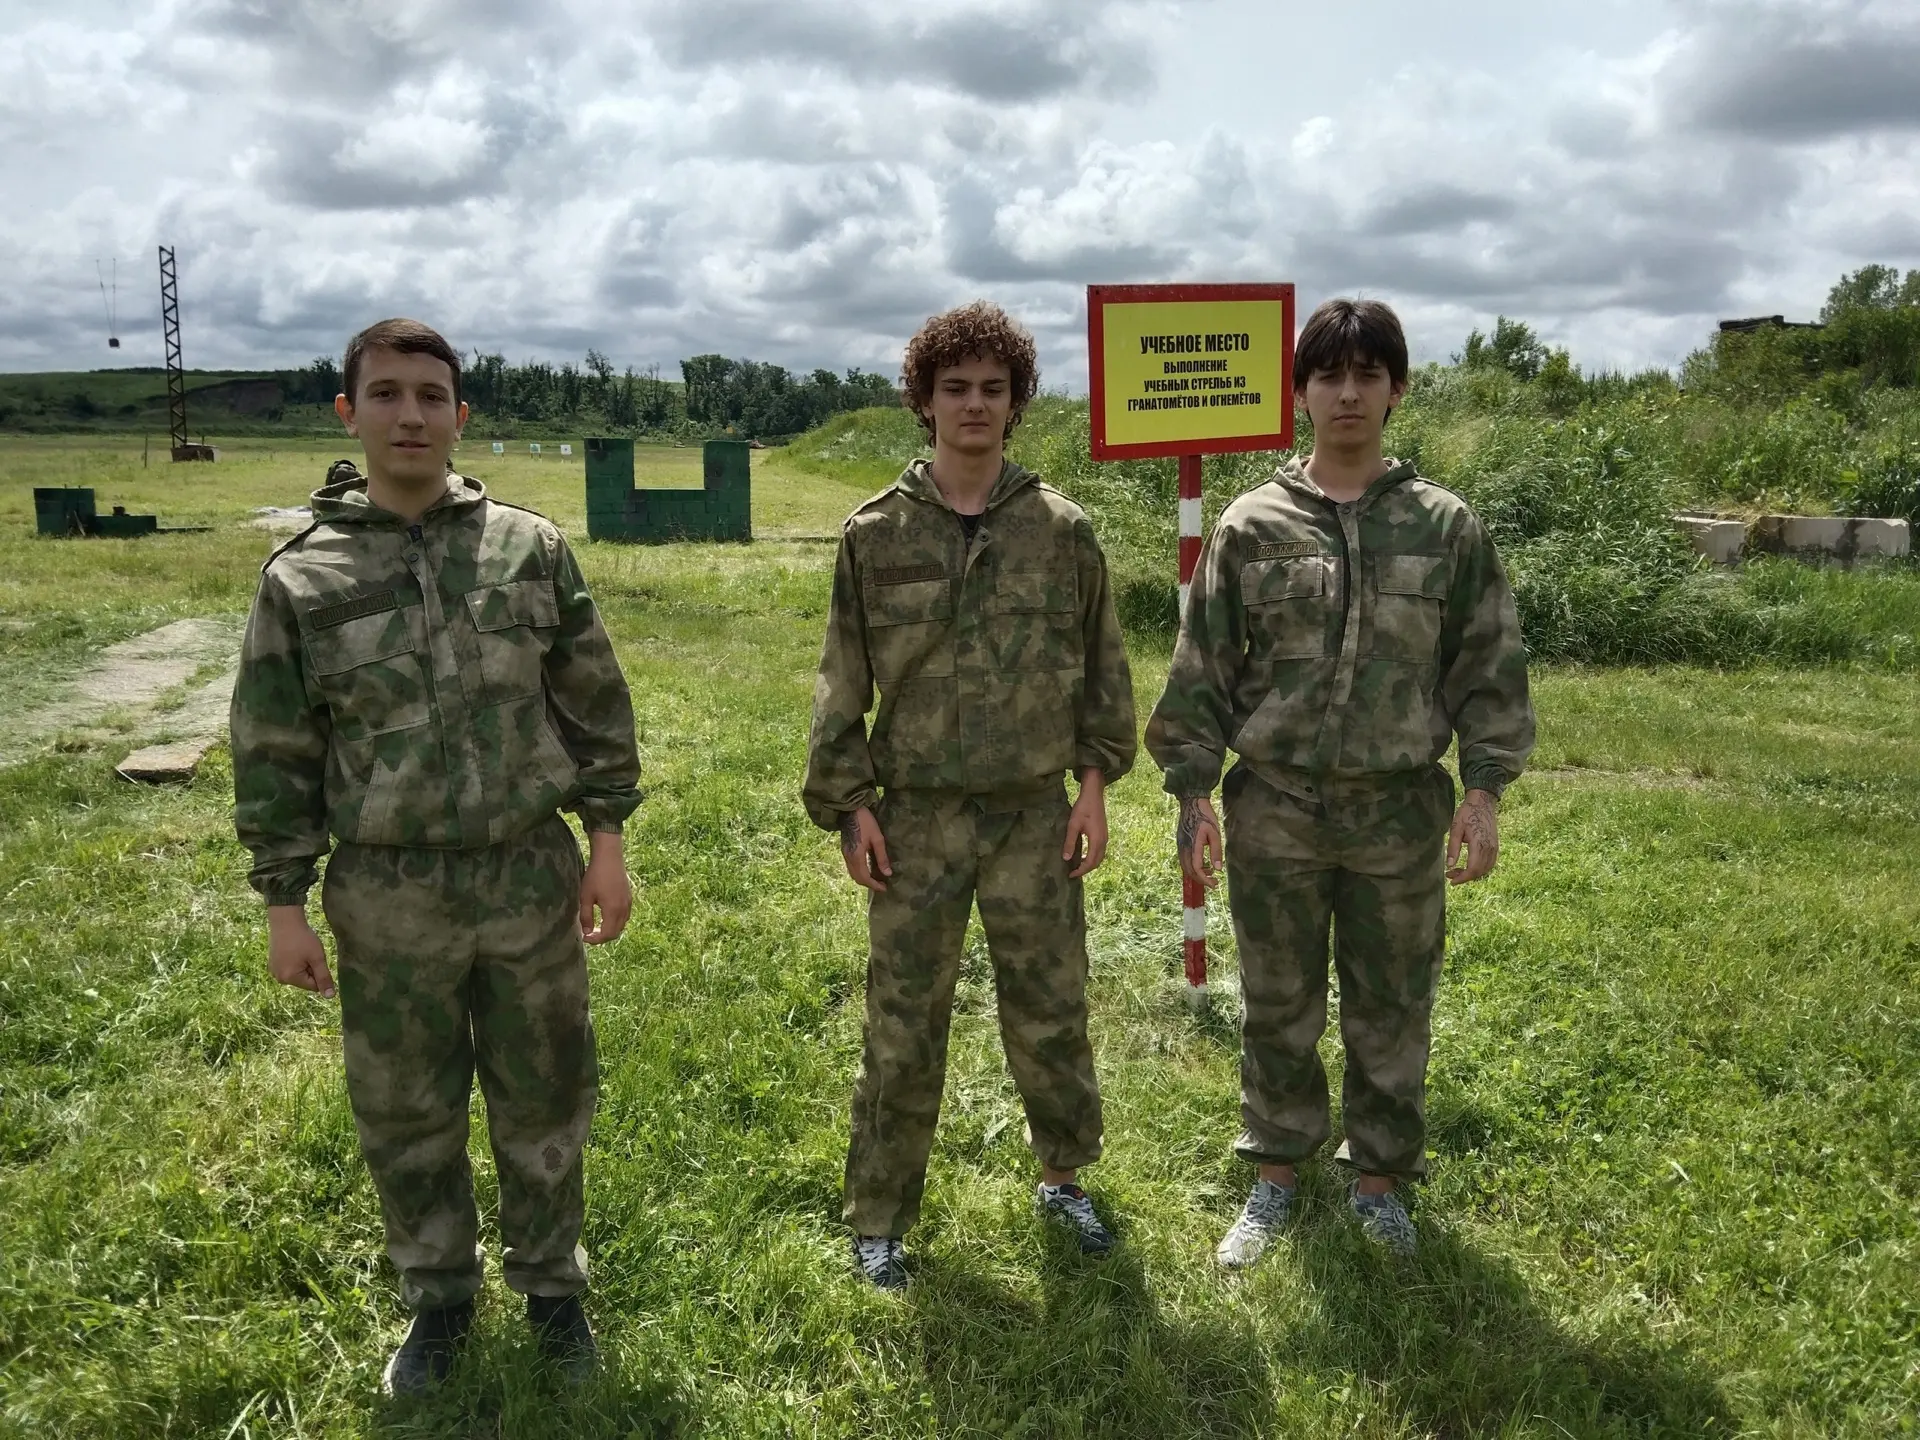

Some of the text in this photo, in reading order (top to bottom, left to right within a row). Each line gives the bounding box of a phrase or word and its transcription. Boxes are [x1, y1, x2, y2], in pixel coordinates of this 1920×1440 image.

[1140, 333, 1249, 354] УЧЕБНОЕ МЕСТО
[1163, 360, 1227, 374] ВЫПОЛНЕНИЕ
[1144, 376, 1246, 392] УЧЕБНЫХ СТРЕЛЬБ ИЗ
[1127, 392, 1261, 411] ГРАНАТОМЁТОВ И ОГНЕМЁТОВ
